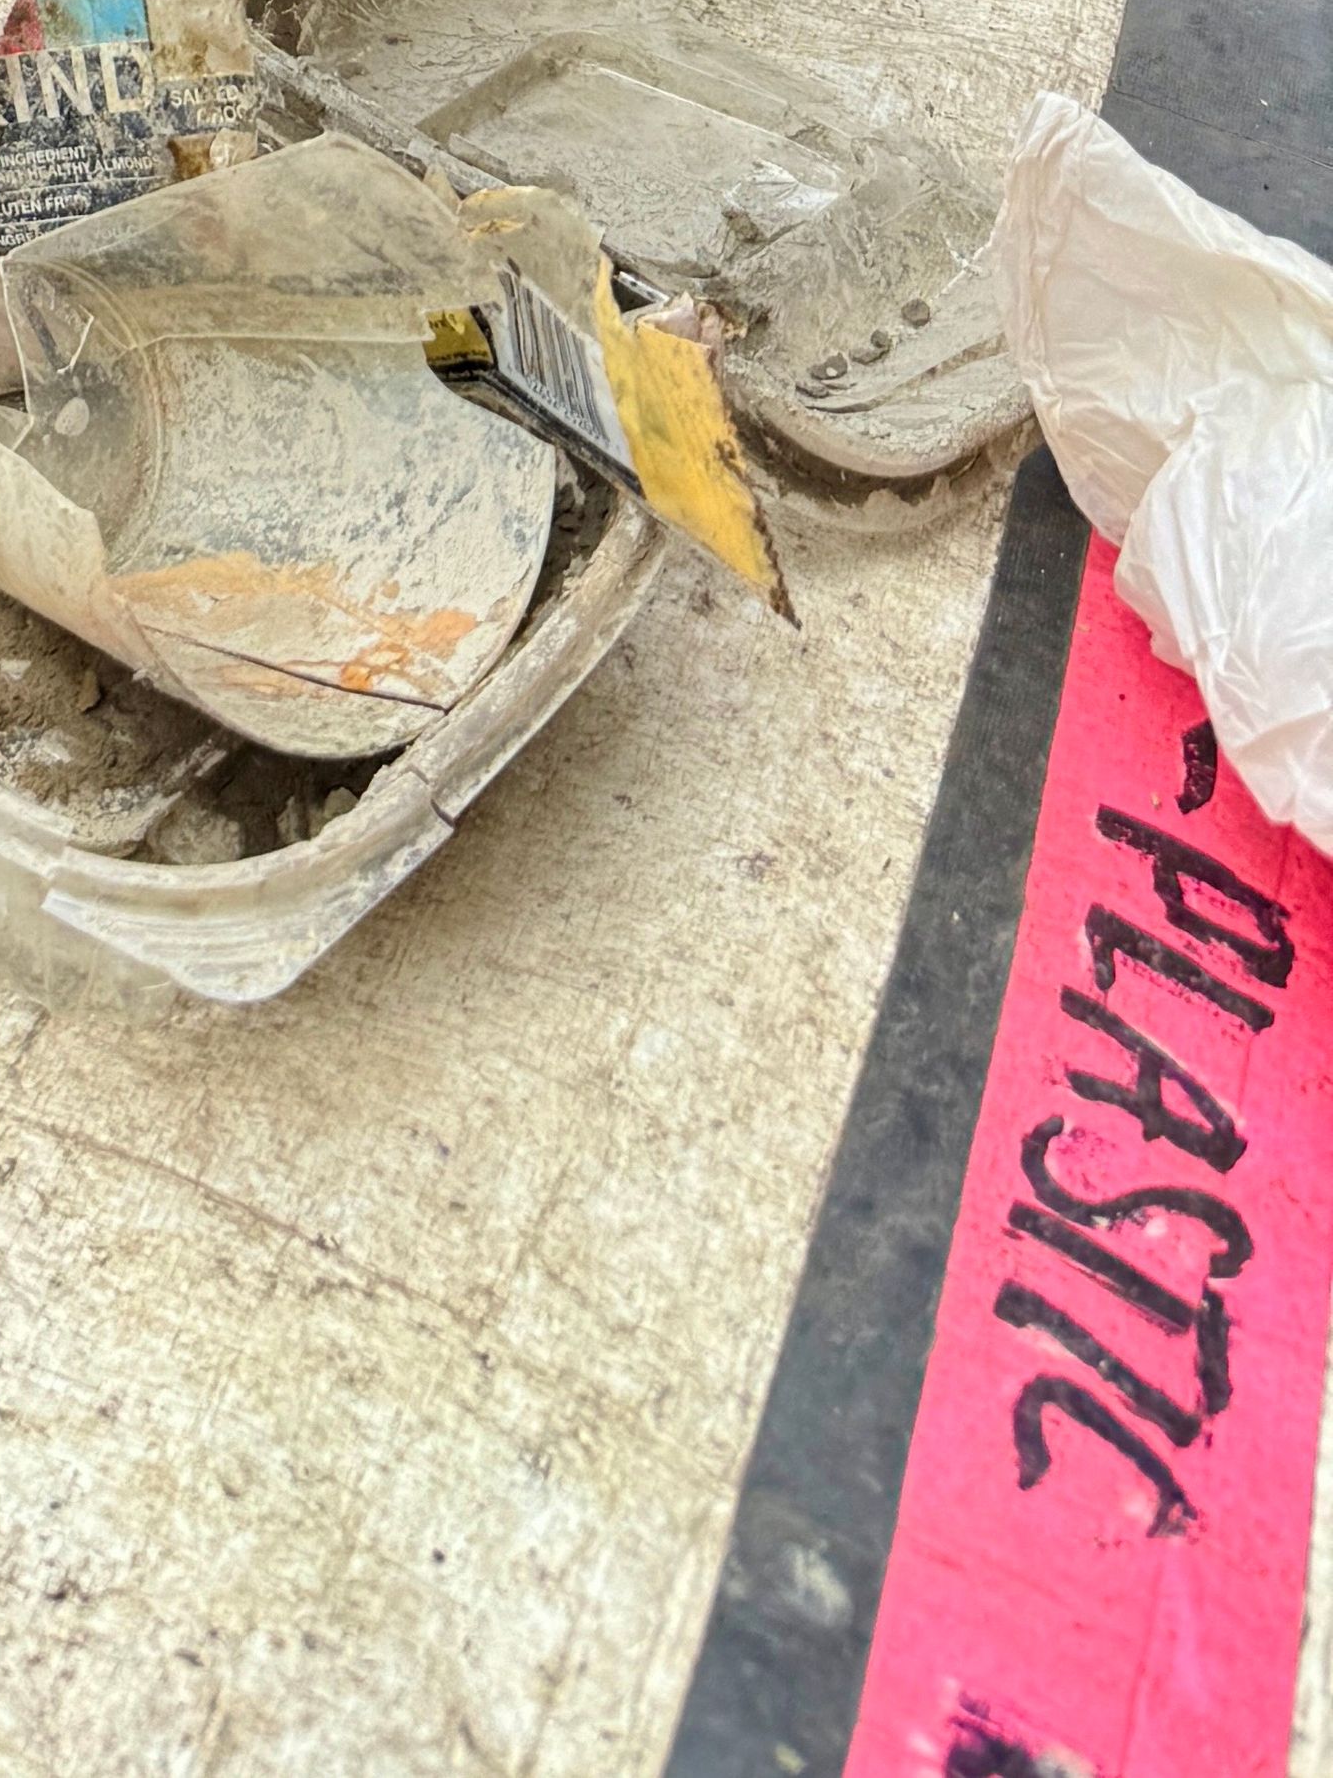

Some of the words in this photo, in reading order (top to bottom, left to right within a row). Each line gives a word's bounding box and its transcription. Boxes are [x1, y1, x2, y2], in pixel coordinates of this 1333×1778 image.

[170, 84, 239, 107] SALED
[0, 145, 87, 167] INGREDIENT
[91, 152, 162, 174] ALMONDS
[994, 804, 1295, 1539] PLASTIC
